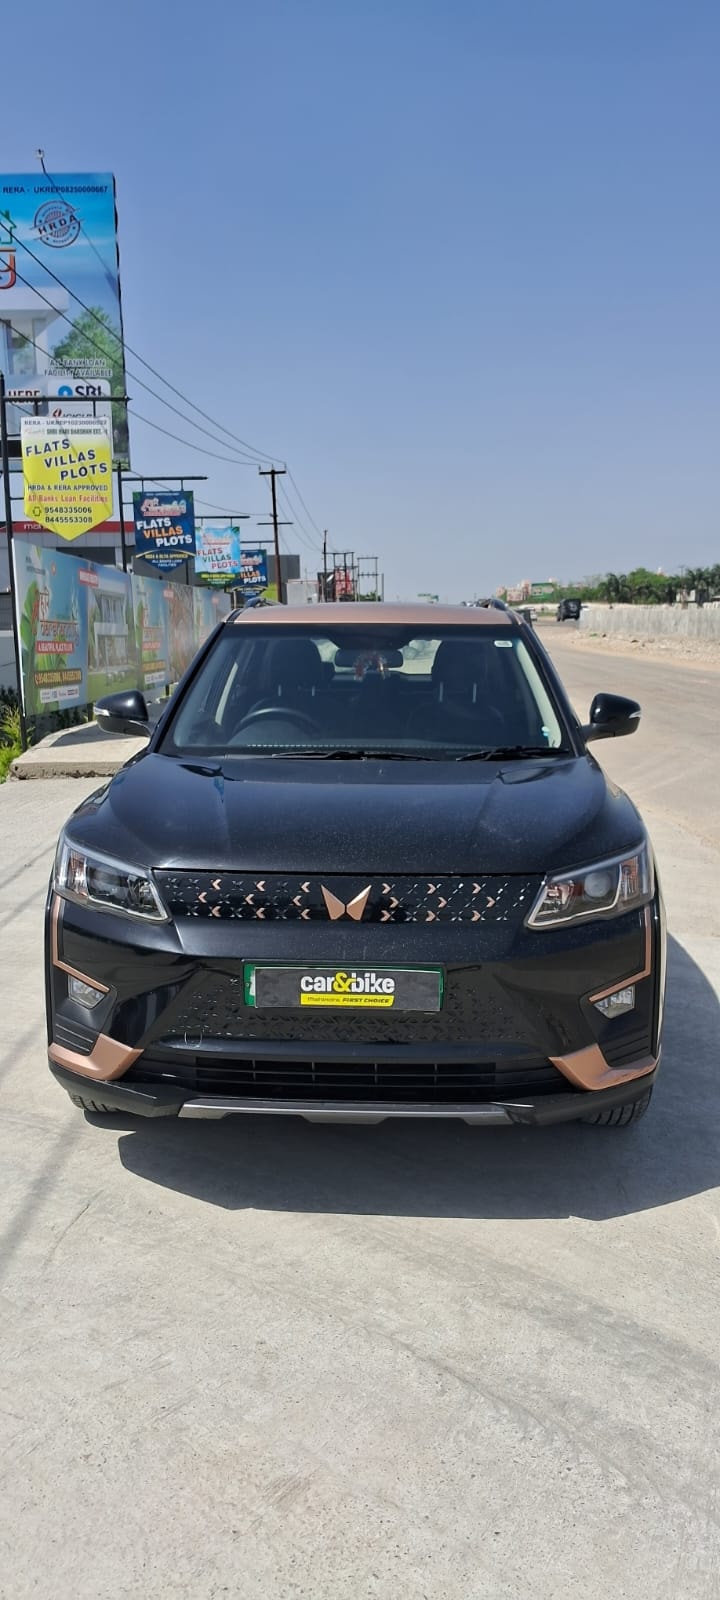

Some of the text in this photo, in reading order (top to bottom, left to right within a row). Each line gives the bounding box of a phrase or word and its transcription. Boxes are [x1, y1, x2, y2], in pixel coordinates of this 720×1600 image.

[38, 214, 78, 235] HRDA
[76, 368, 112, 376] AVAILABLE
[25, 438, 71, 457] FLATS
[44, 449, 96, 468] VILLAS
[60, 462, 108, 481] PLOTS
[39, 494, 58, 502] Banks
[61, 494, 76, 502] Loan
[80, 494, 108, 502] Facilities
[44, 506, 92, 514] 9548335006
[45, 516, 92, 524] 8445553308
[136, 518, 171, 530] FLATS
[144, 526, 183, 539] VILLAS
[156, 535, 193, 547] PLOTS
[212, 561, 238, 569] PLOTS
[244, 575, 266, 584] PLOTS
[300, 971, 395, 994] car&bike
